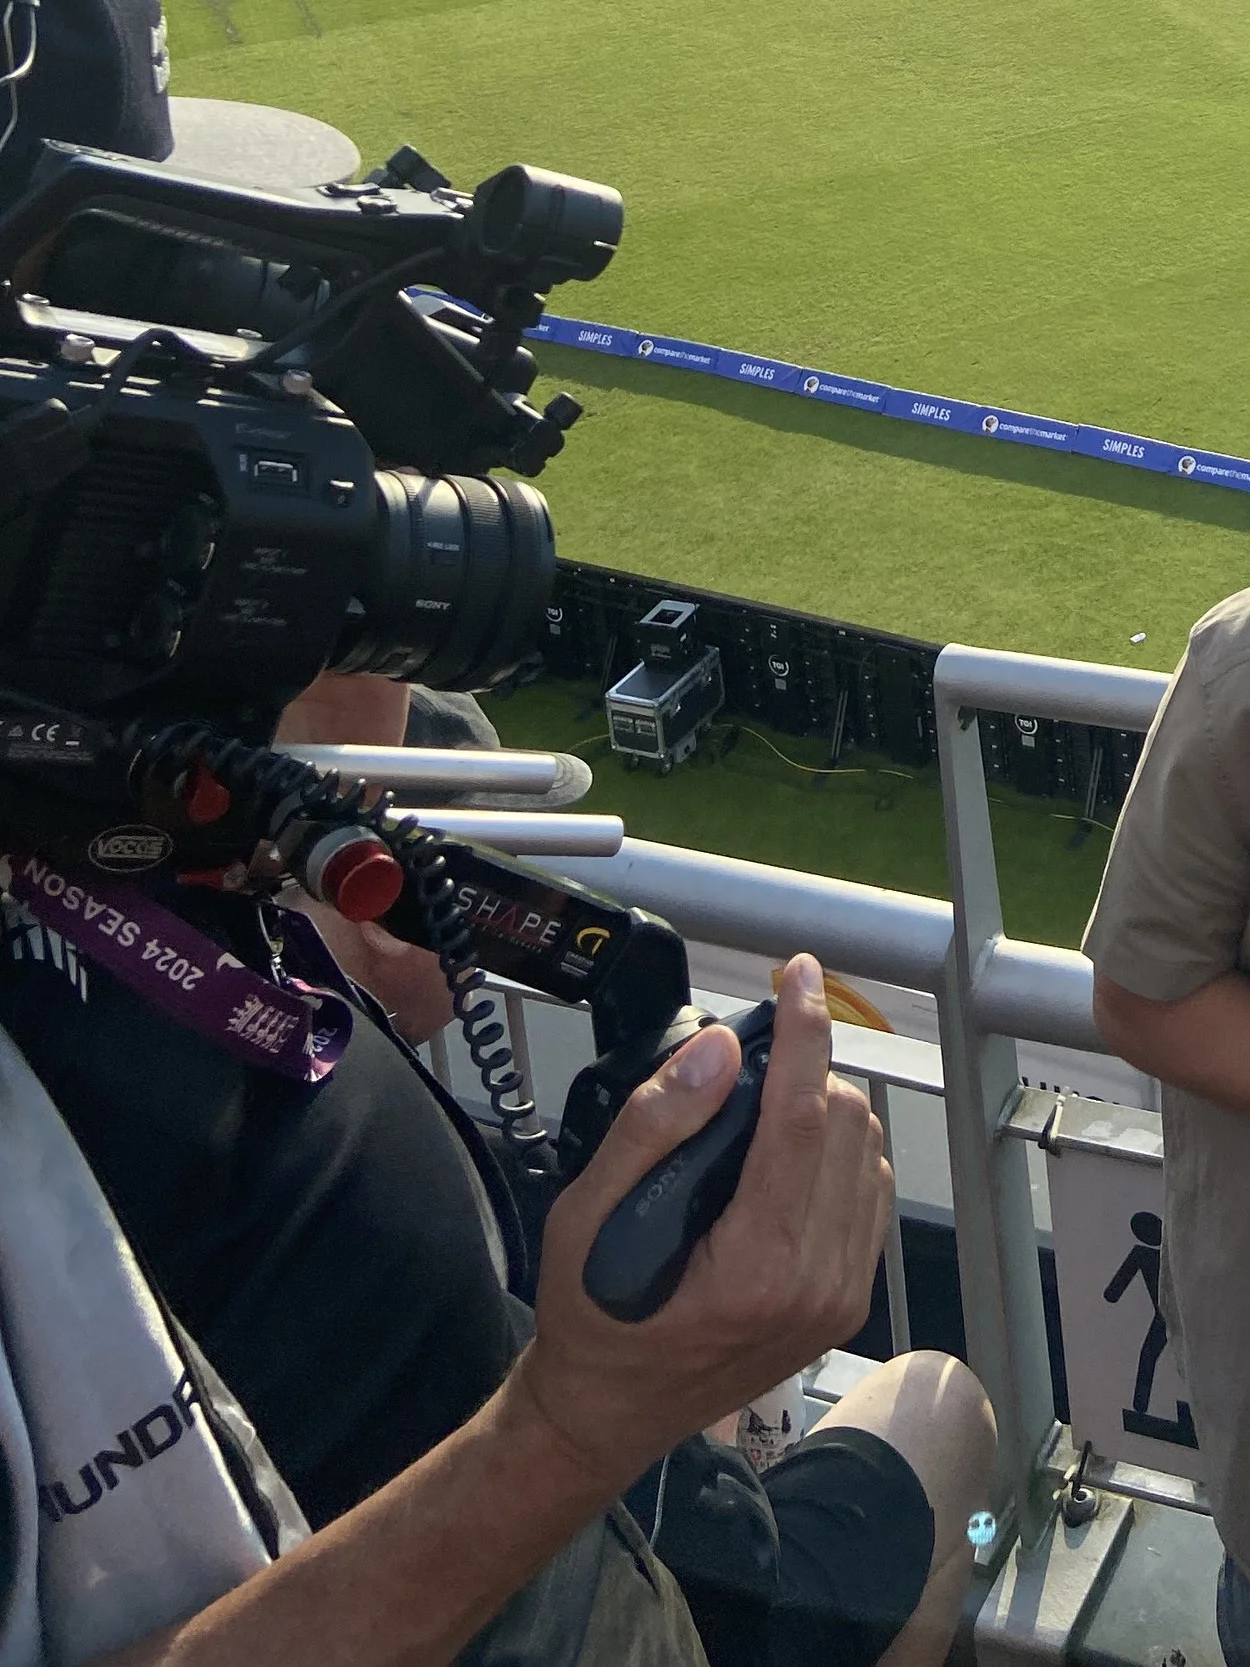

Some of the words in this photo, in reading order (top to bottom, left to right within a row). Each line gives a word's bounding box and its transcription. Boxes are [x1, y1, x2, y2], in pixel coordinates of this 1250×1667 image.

[578, 330, 613, 347] SIMPLES
[739, 362, 776, 381] SIMPLES
[911, 401, 952, 422] SIMPLES
[1102, 438, 1145, 460] SIMPLES
[415, 599, 453, 610] SONY
[23, 857, 141, 947] SEASON
[141, 938, 205, 990] 2024
